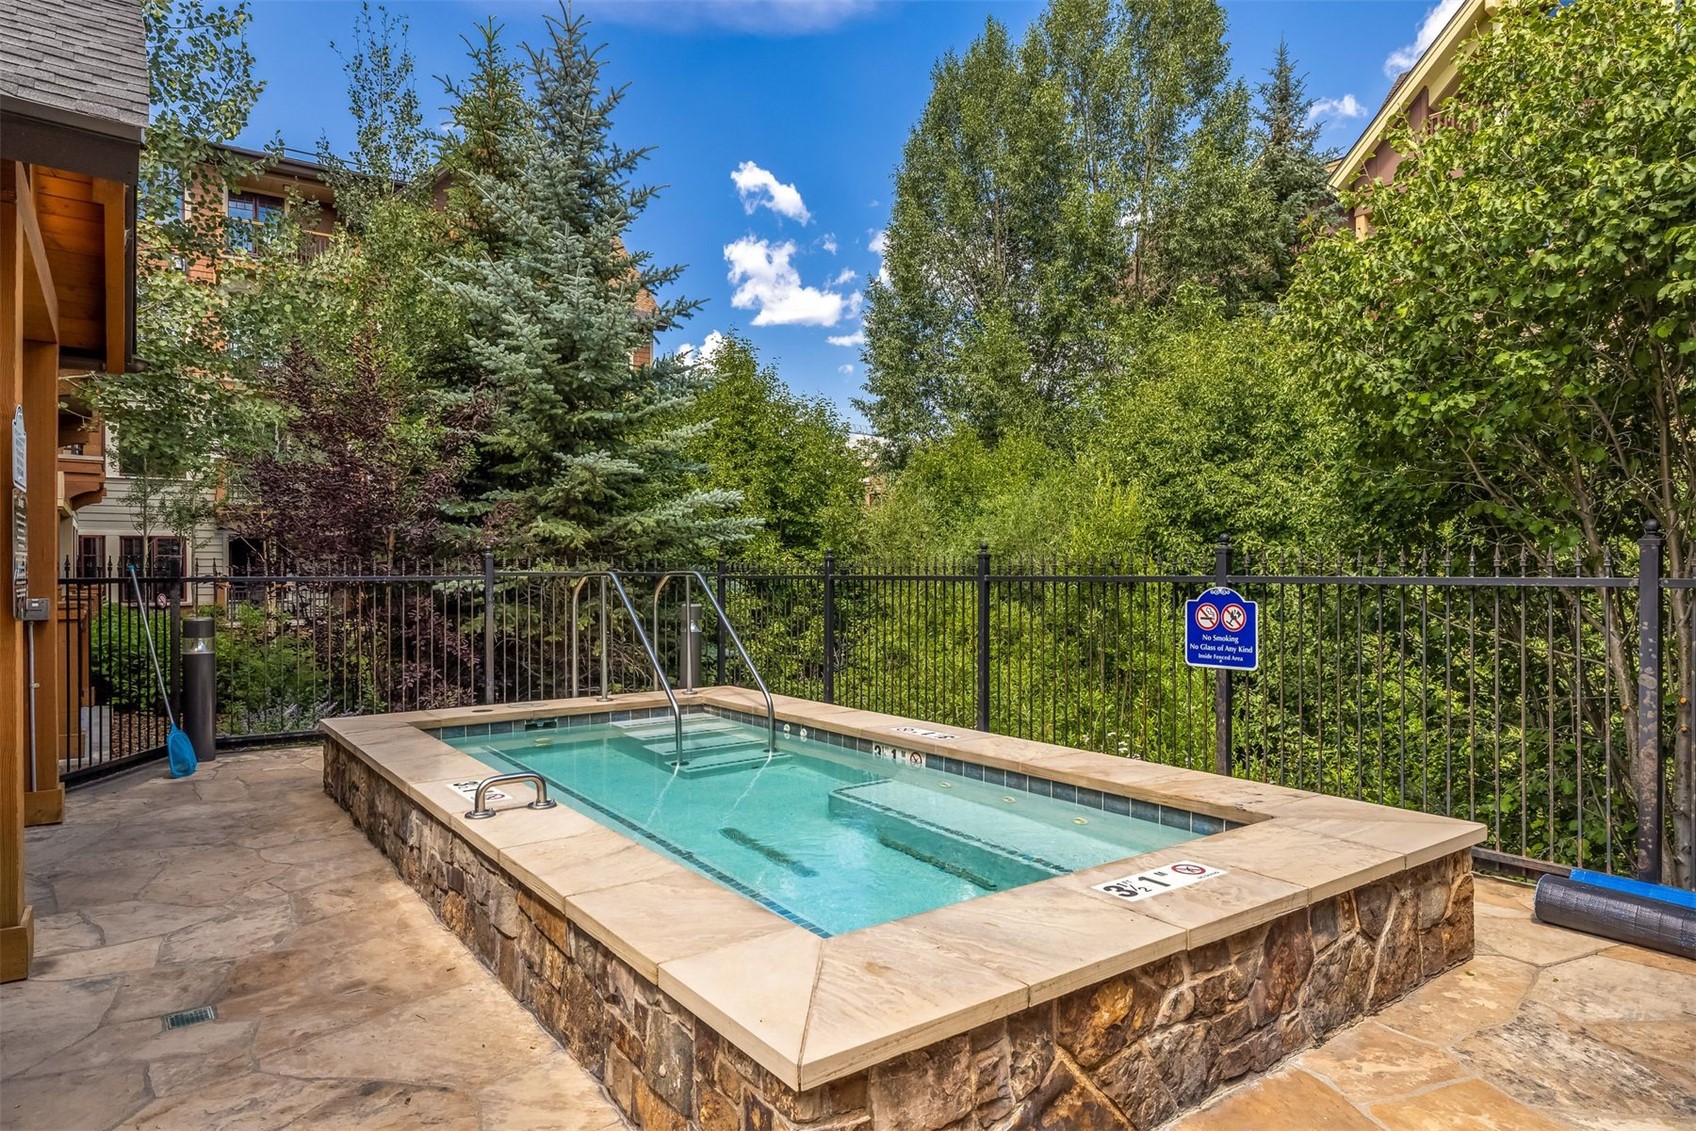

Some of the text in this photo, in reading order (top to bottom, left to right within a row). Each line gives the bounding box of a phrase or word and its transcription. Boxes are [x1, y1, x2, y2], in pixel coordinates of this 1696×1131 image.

[1213, 635, 1239, 644] Smoking
[1225, 646, 1237, 654] Any
[1138, 876, 1171, 887] 1
